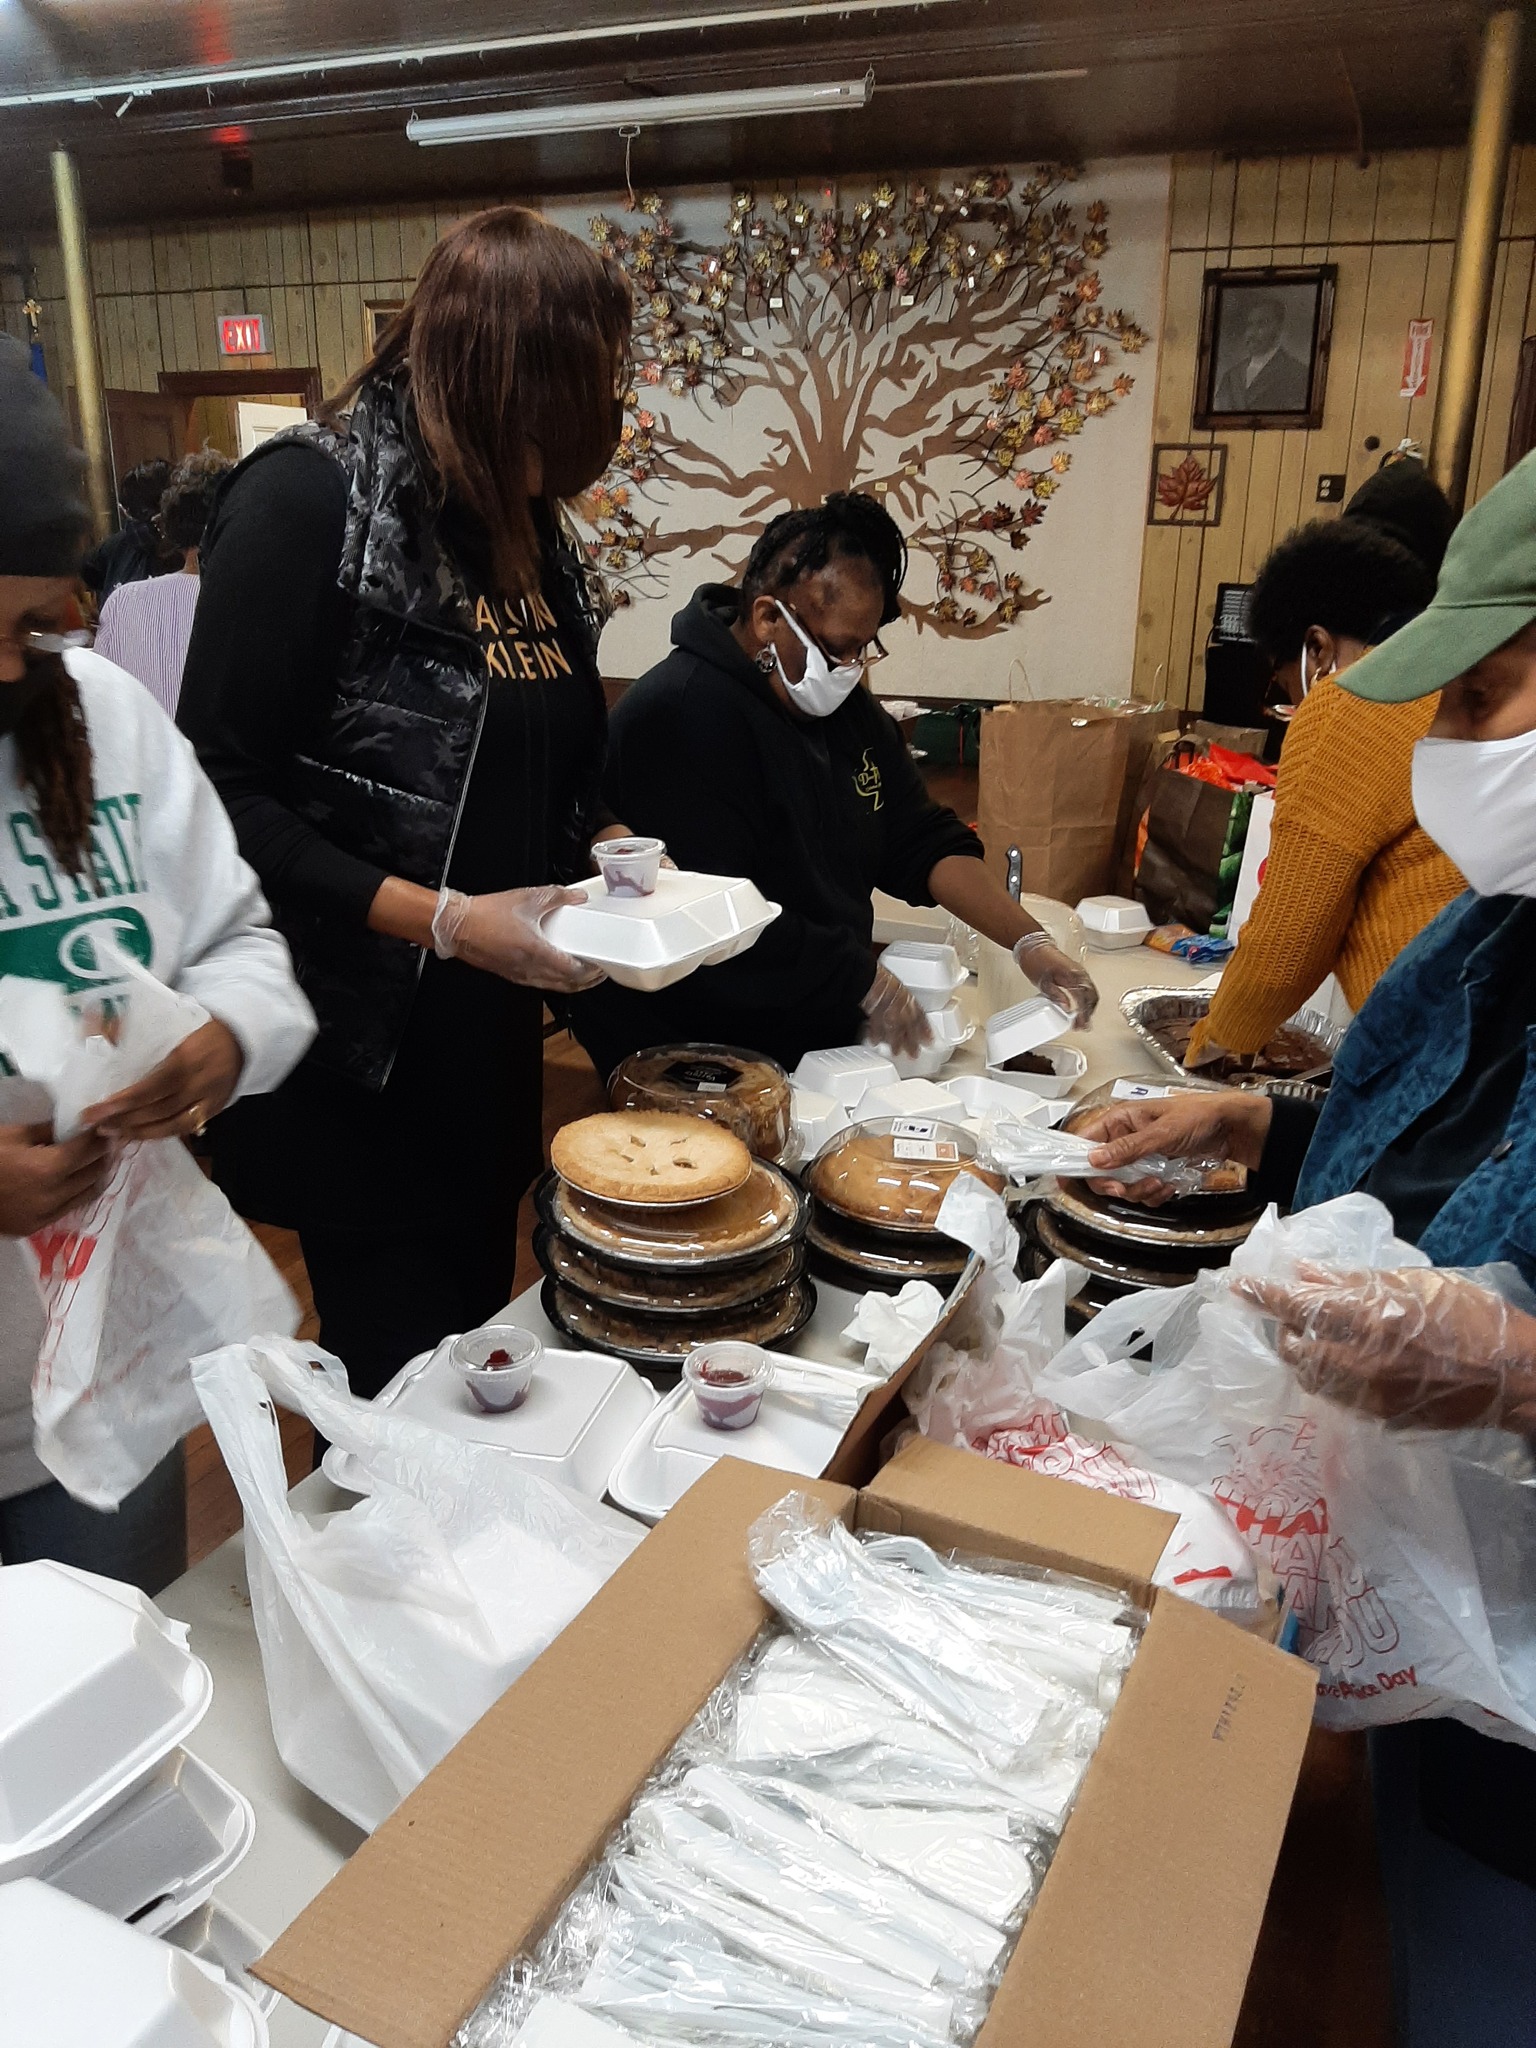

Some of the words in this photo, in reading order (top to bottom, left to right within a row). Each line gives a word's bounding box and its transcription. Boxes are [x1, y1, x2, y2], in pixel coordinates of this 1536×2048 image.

[223, 319, 261, 352] EXIT
[475, 593, 558, 635] ALVIN
[486, 637, 573, 680] KLEIN
[1376, 1665, 1418, 1690] Day
